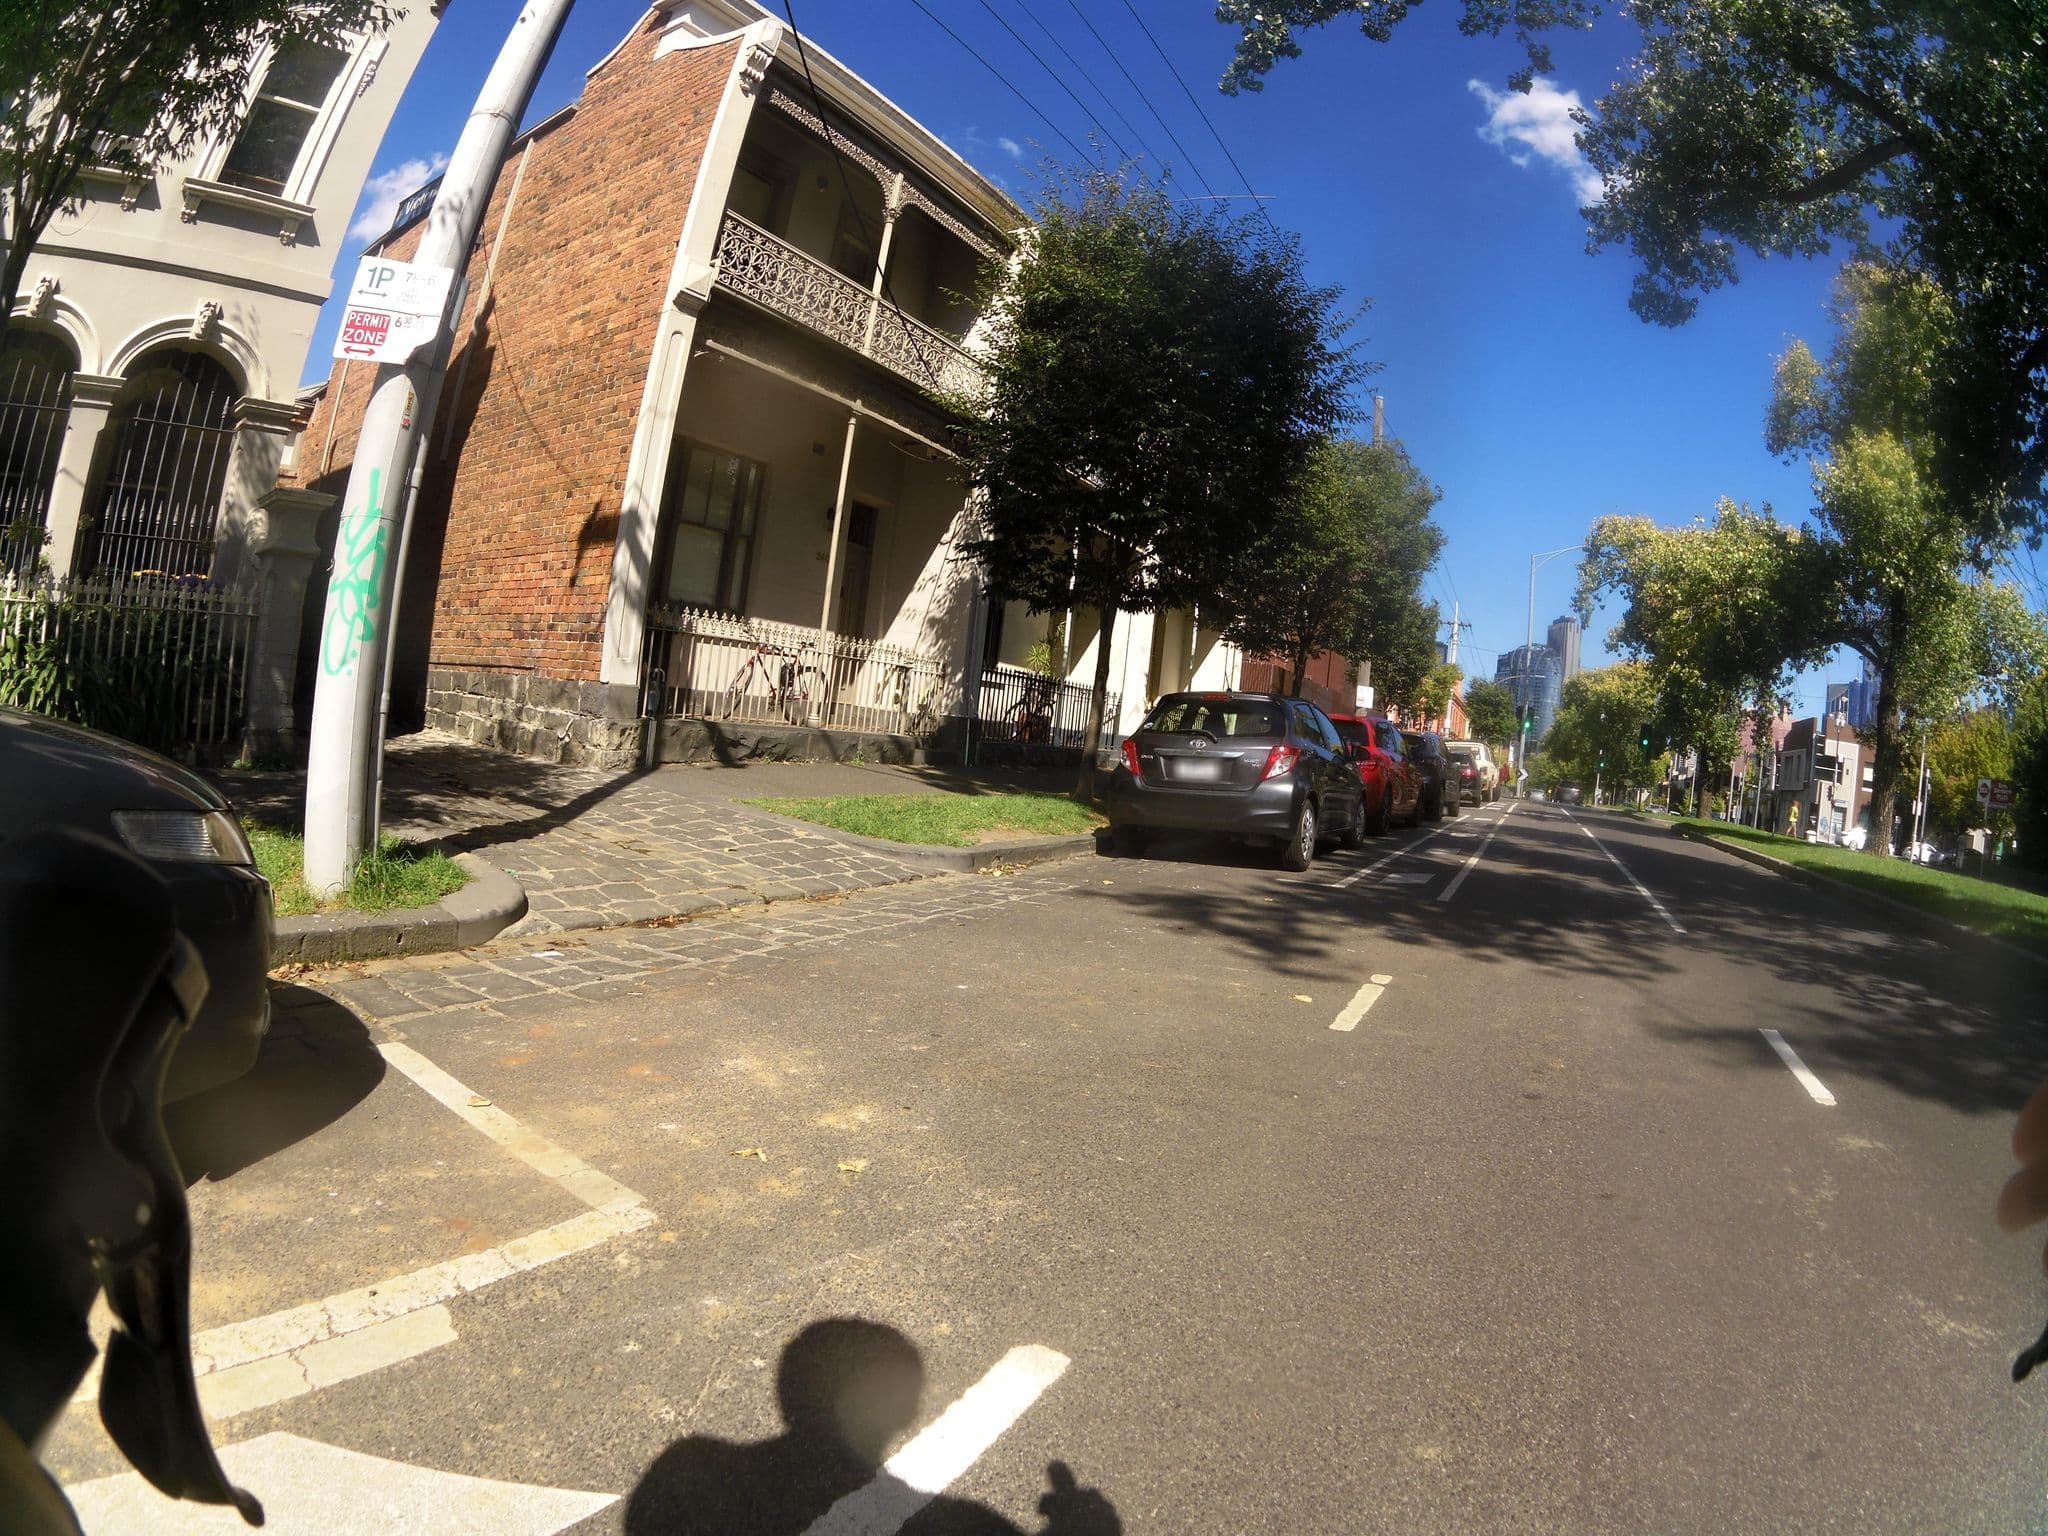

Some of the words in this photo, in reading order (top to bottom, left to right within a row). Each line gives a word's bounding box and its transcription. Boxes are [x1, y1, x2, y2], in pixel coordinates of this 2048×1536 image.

[367, 266, 395, 288] 1P
[347, 311, 391, 329] PERMIT
[342, 328, 386, 345] ZONE
